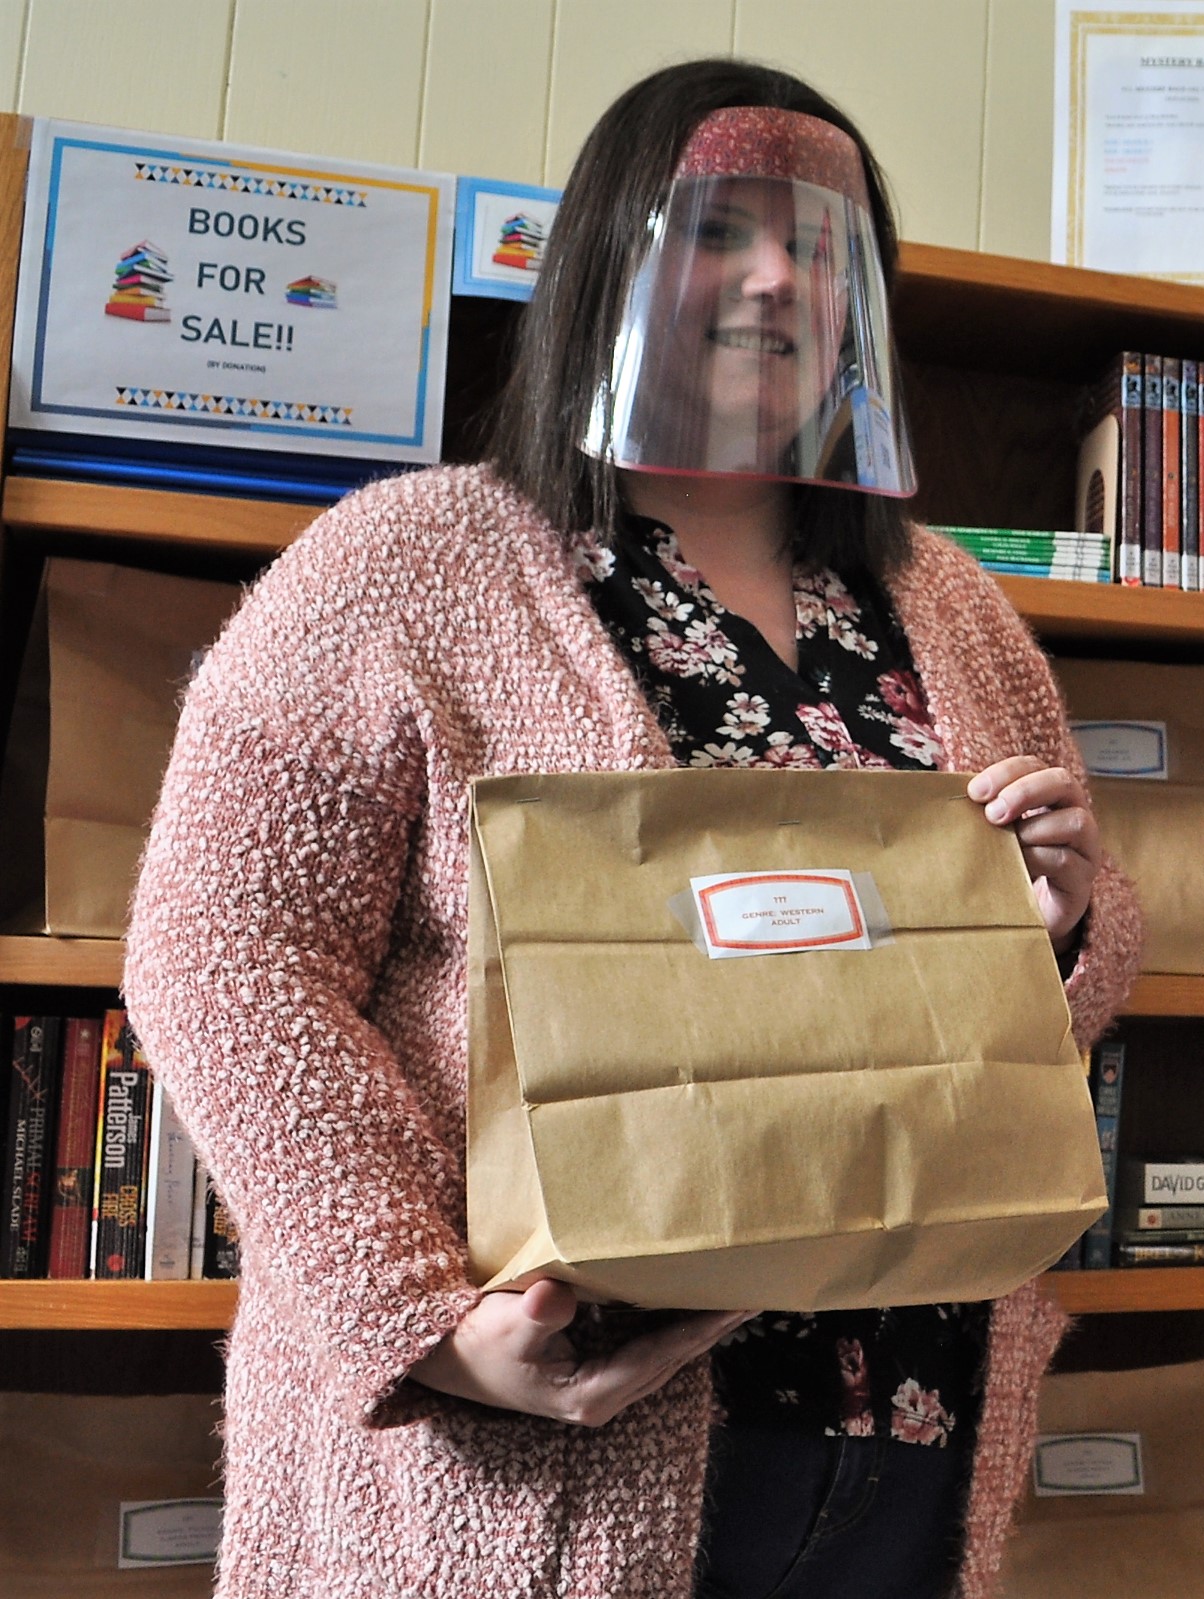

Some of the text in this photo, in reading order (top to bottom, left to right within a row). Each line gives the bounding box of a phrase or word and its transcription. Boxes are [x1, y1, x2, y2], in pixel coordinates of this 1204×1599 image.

[1139, 57, 1194, 68] MYSTERY
[188, 207, 306, 246] BOOKS
[197, 262, 266, 295] FOR
[180, 314, 294, 352] SALE!!
[742, 908, 824, 919] GENRE: WESTERN
[771, 918, 801, 926] ADULT
[104, 1071, 137, 1168] Patterson
[127, 1113, 141, 1143] James
[10, 1119, 26, 1232] MICHAEL SLADE
[22, 1107, 46, 1241] PRIMAL SCREAM
[1152, 1175, 1194, 1197] DAVID
[101, 1193, 119, 1219] FIRE
[119, 1185, 138, 1227] CROSS
